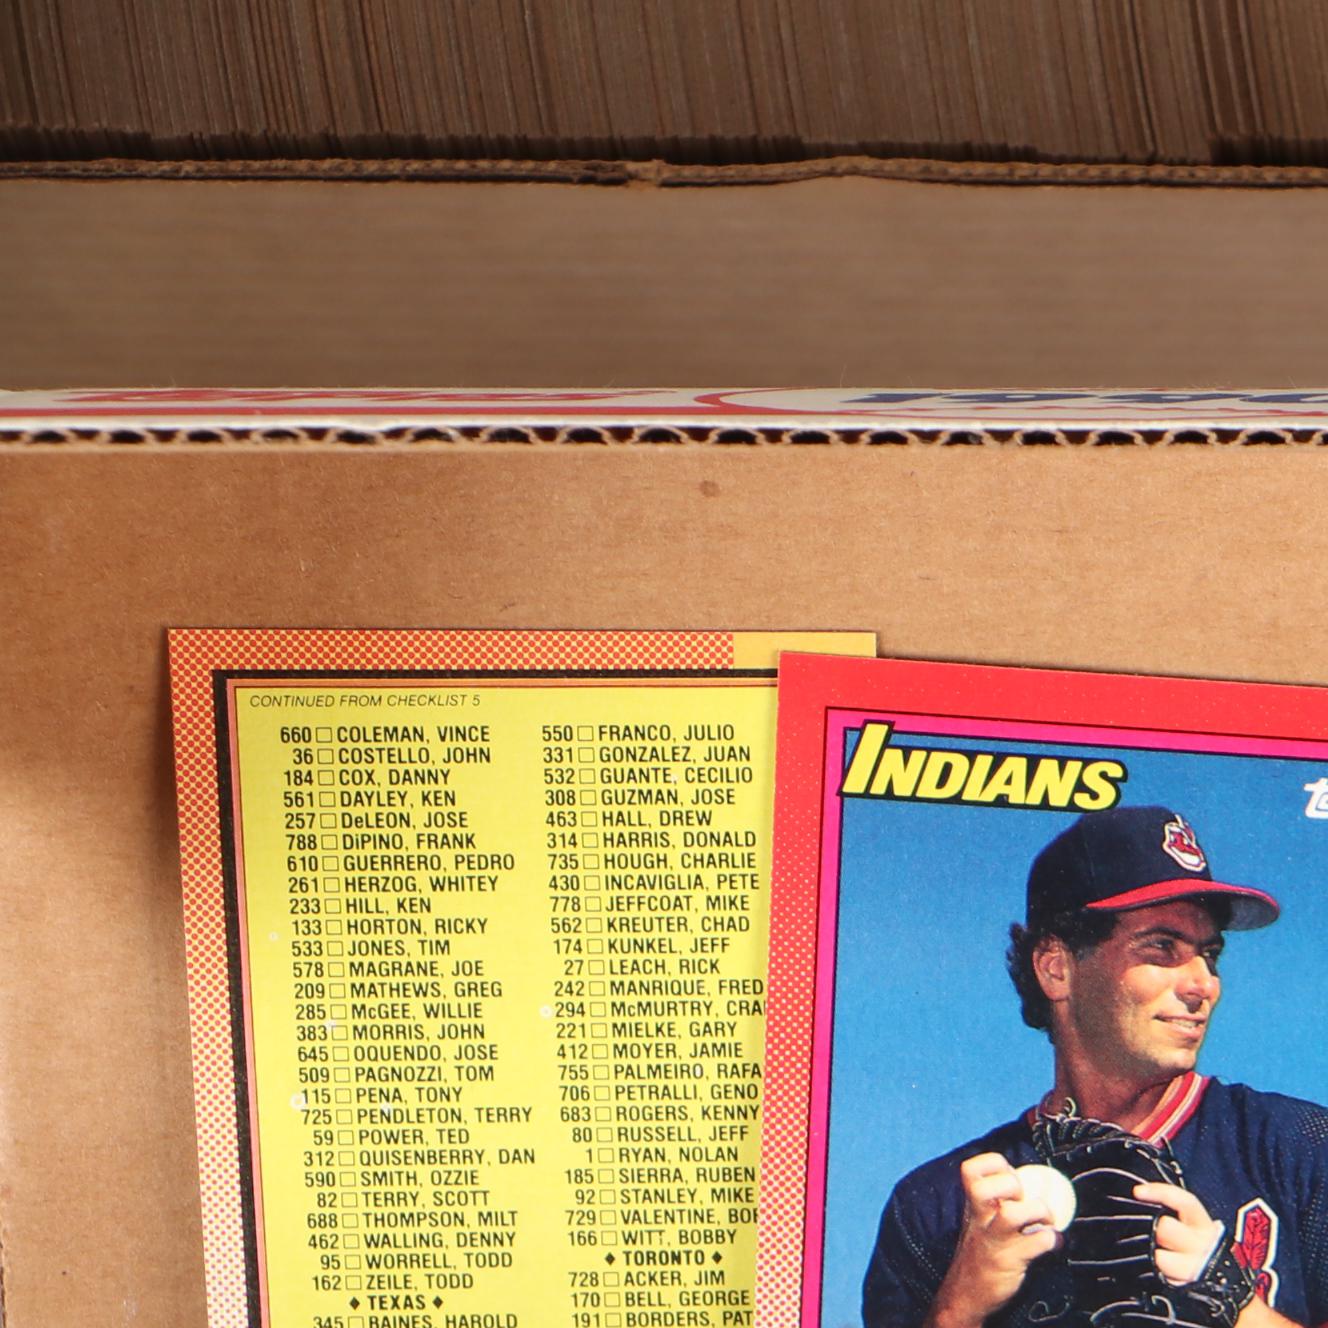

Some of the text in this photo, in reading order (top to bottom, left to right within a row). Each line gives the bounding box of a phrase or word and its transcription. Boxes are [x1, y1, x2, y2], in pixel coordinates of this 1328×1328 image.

[249, 694, 481, 708] CONTINUED FROM CHECKLIST 5
[279, 725, 490, 744] 660 COLEMAN, VINCE
[292, 746, 491, 765] 36 COSTELLO, JOHN
[543, 745, 751, 764] 331 GONZALEZ, JUAN
[839, 721, 1125, 811] INDIANS
[545, 788, 736, 807] 308 GUZMAN, JOSE
[284, 811, 468, 830] 257 DeLEON, JOSE
[287, 853, 515, 873] 610 GUERRERO, PEDRO
[553, 937, 730, 955] 174 KUNKEL, JEFF
[296, 1023, 485, 1042] 383 MORRIS, JOHN
[300, 1106, 532, 1125] 725 PENDLETON, TERRY
[586, 1146, 739, 1164] 1 RYAN, NOLAN
[304, 1169, 479, 1188] 590 SMITH, OZZIE
[622, 1249, 706, 1267] TORONTO
[366, 1294, 428, 1312] TEXAS
[572, 1289, 751, 1308] 170 BELL, GEORGE
